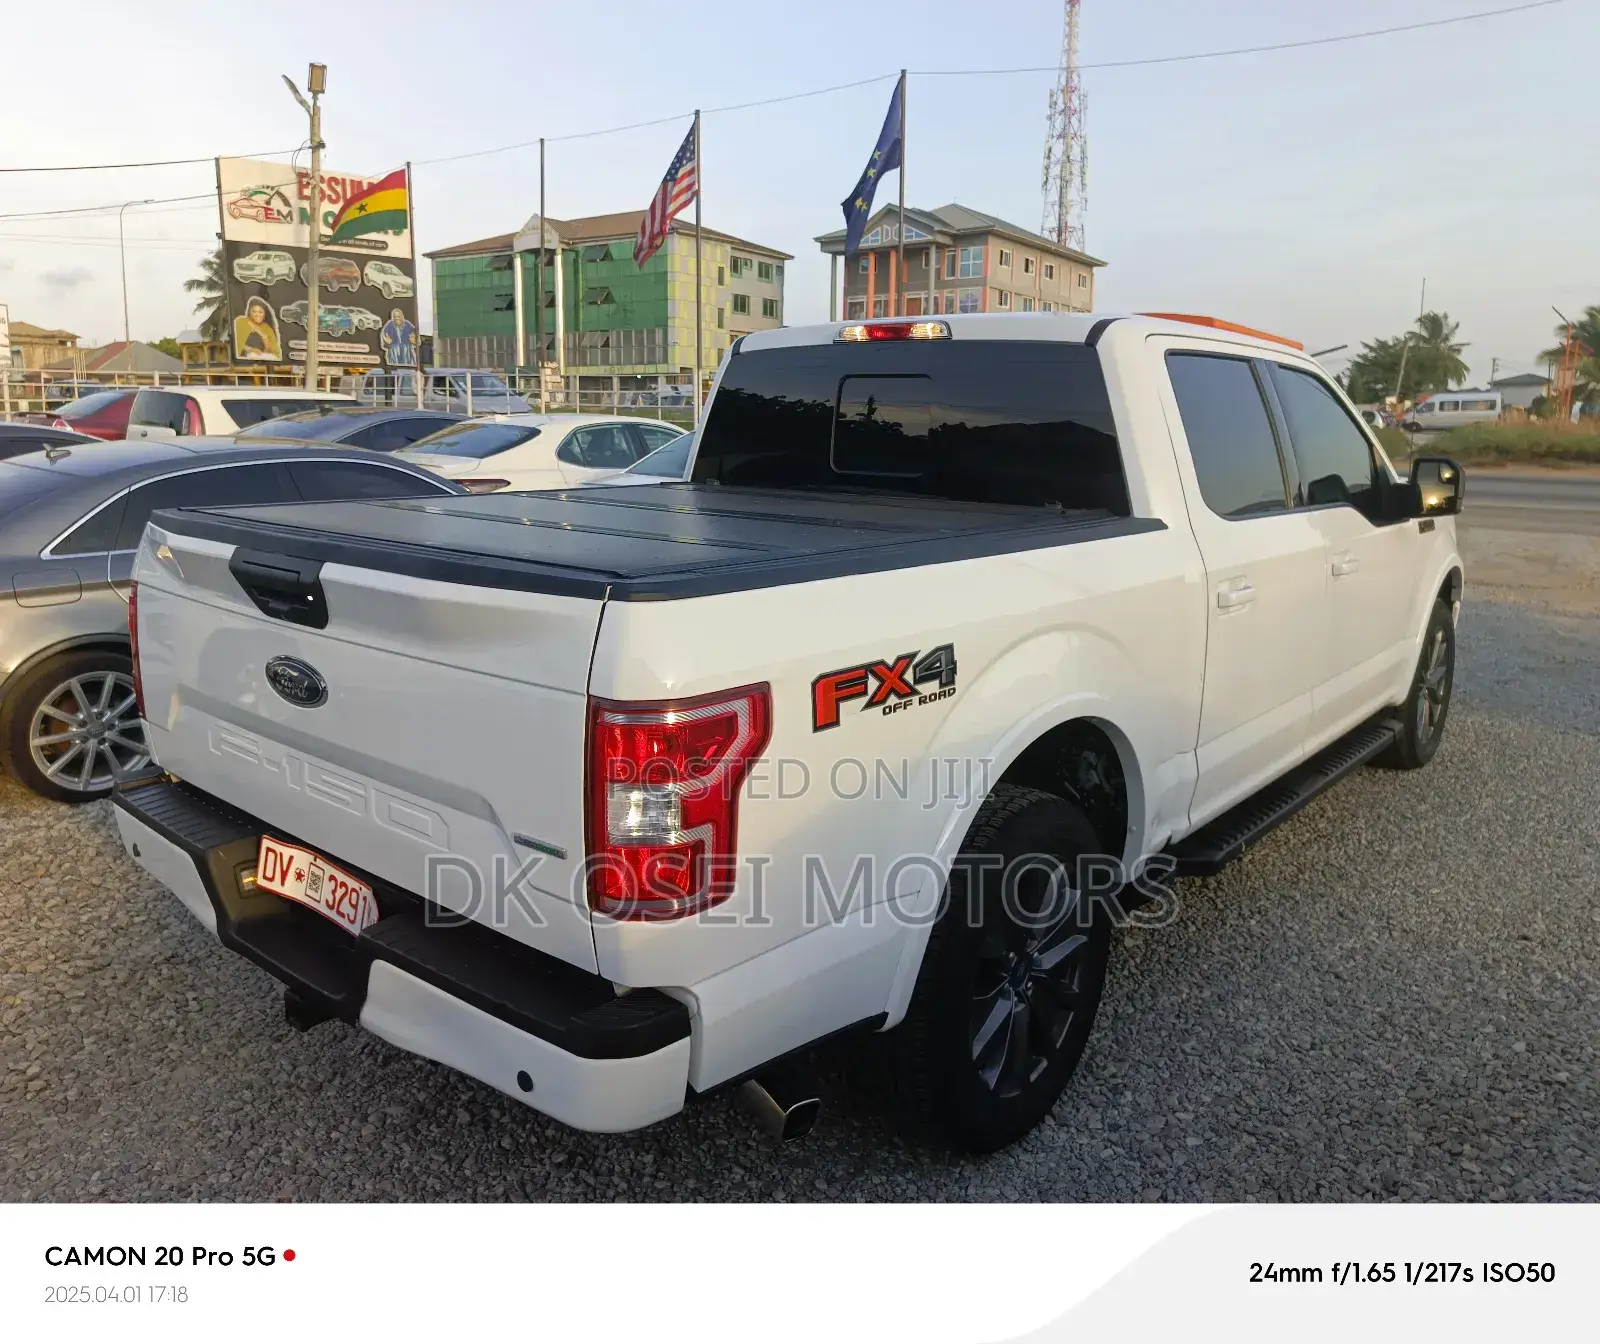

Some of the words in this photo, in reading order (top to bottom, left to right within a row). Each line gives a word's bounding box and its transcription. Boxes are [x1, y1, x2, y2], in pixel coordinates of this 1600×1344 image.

[811, 642, 957, 733] FX4
[882, 699, 913, 716] OFF
[918, 687, 957, 706] ROAD
[208, 723, 450, 853] F-150
[262, 846, 295, 887] DV
[325, 874, 368, 930] 3291
